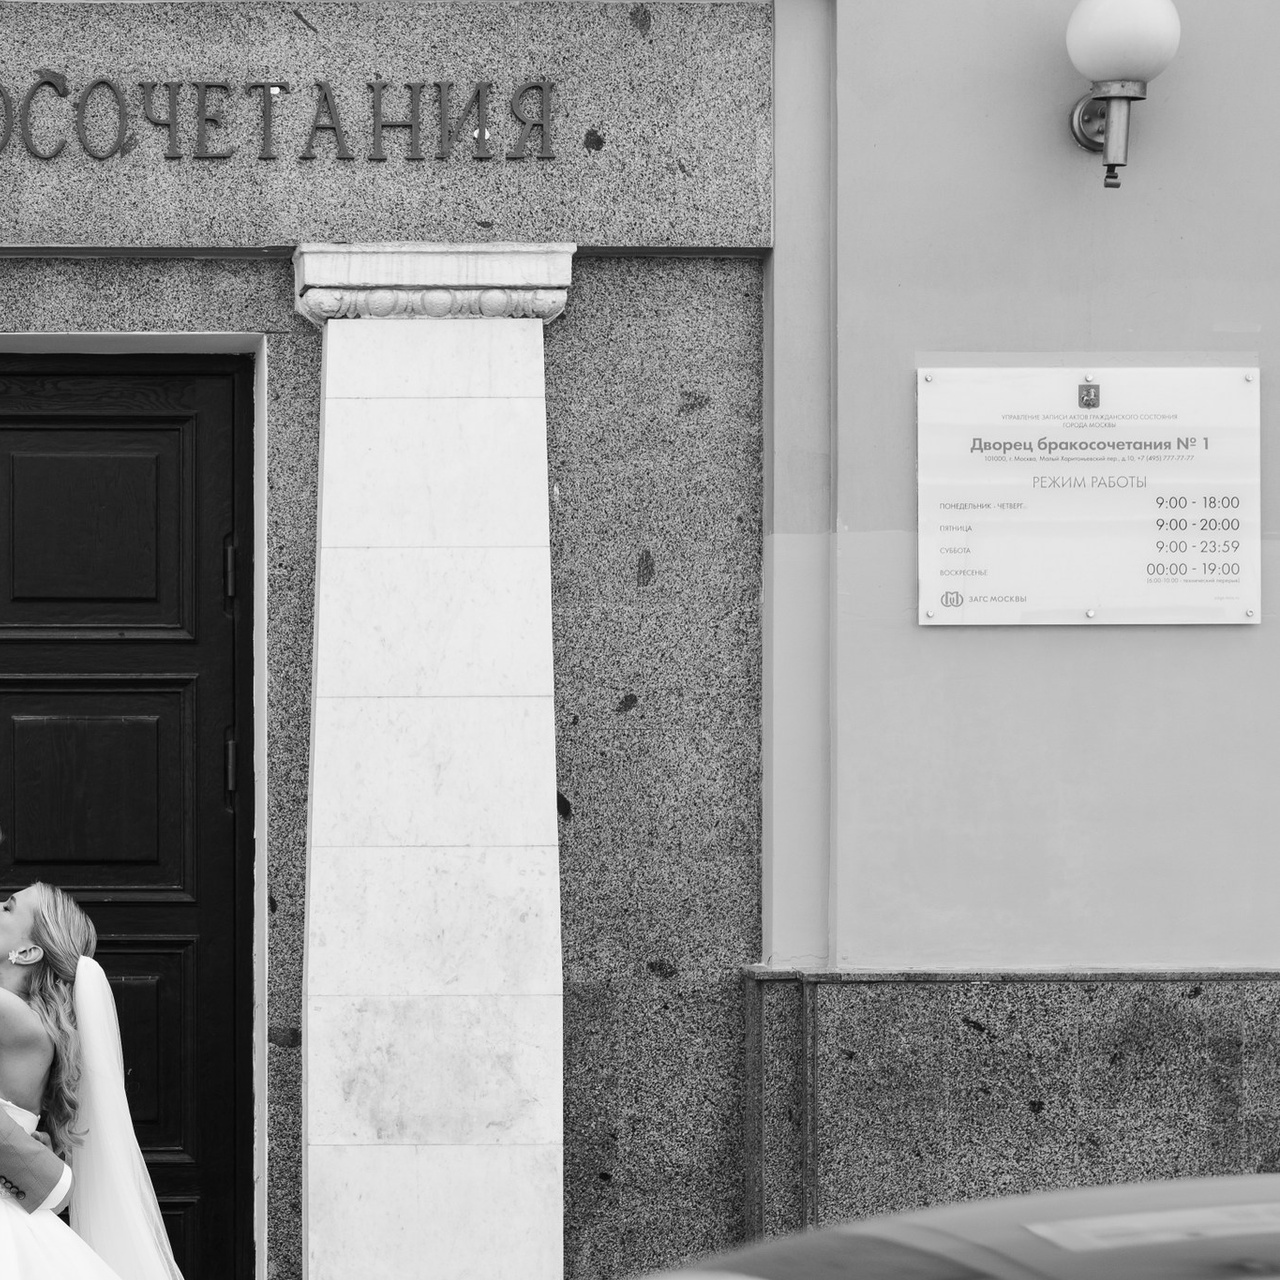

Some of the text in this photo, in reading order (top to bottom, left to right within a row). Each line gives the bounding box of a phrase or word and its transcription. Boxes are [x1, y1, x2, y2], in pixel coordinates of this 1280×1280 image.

[970, 436, 1209, 454] Дворец бракосочетания № 1
[1032, 475, 1147, 489] РЕЖИМ РАБОТЫ
[939, 502, 992, 510] ПОНЕДЕЛЬНИК
[1155, 496, 1188, 509] 9:00
[1203, 496, 1240, 509] 18:00
[1155, 518, 1188, 531] 9:00
[1199, 518, 1240, 531] 20:00
[1155, 540, 1188, 553] 9:00
[1199, 540, 1240, 553] 23:59
[1146, 563, 1188, 575] 00:00
[1202, 563, 1240, 575] 19:00
[968, 595, 1027, 603] ЗАГС МОСКВЫ
